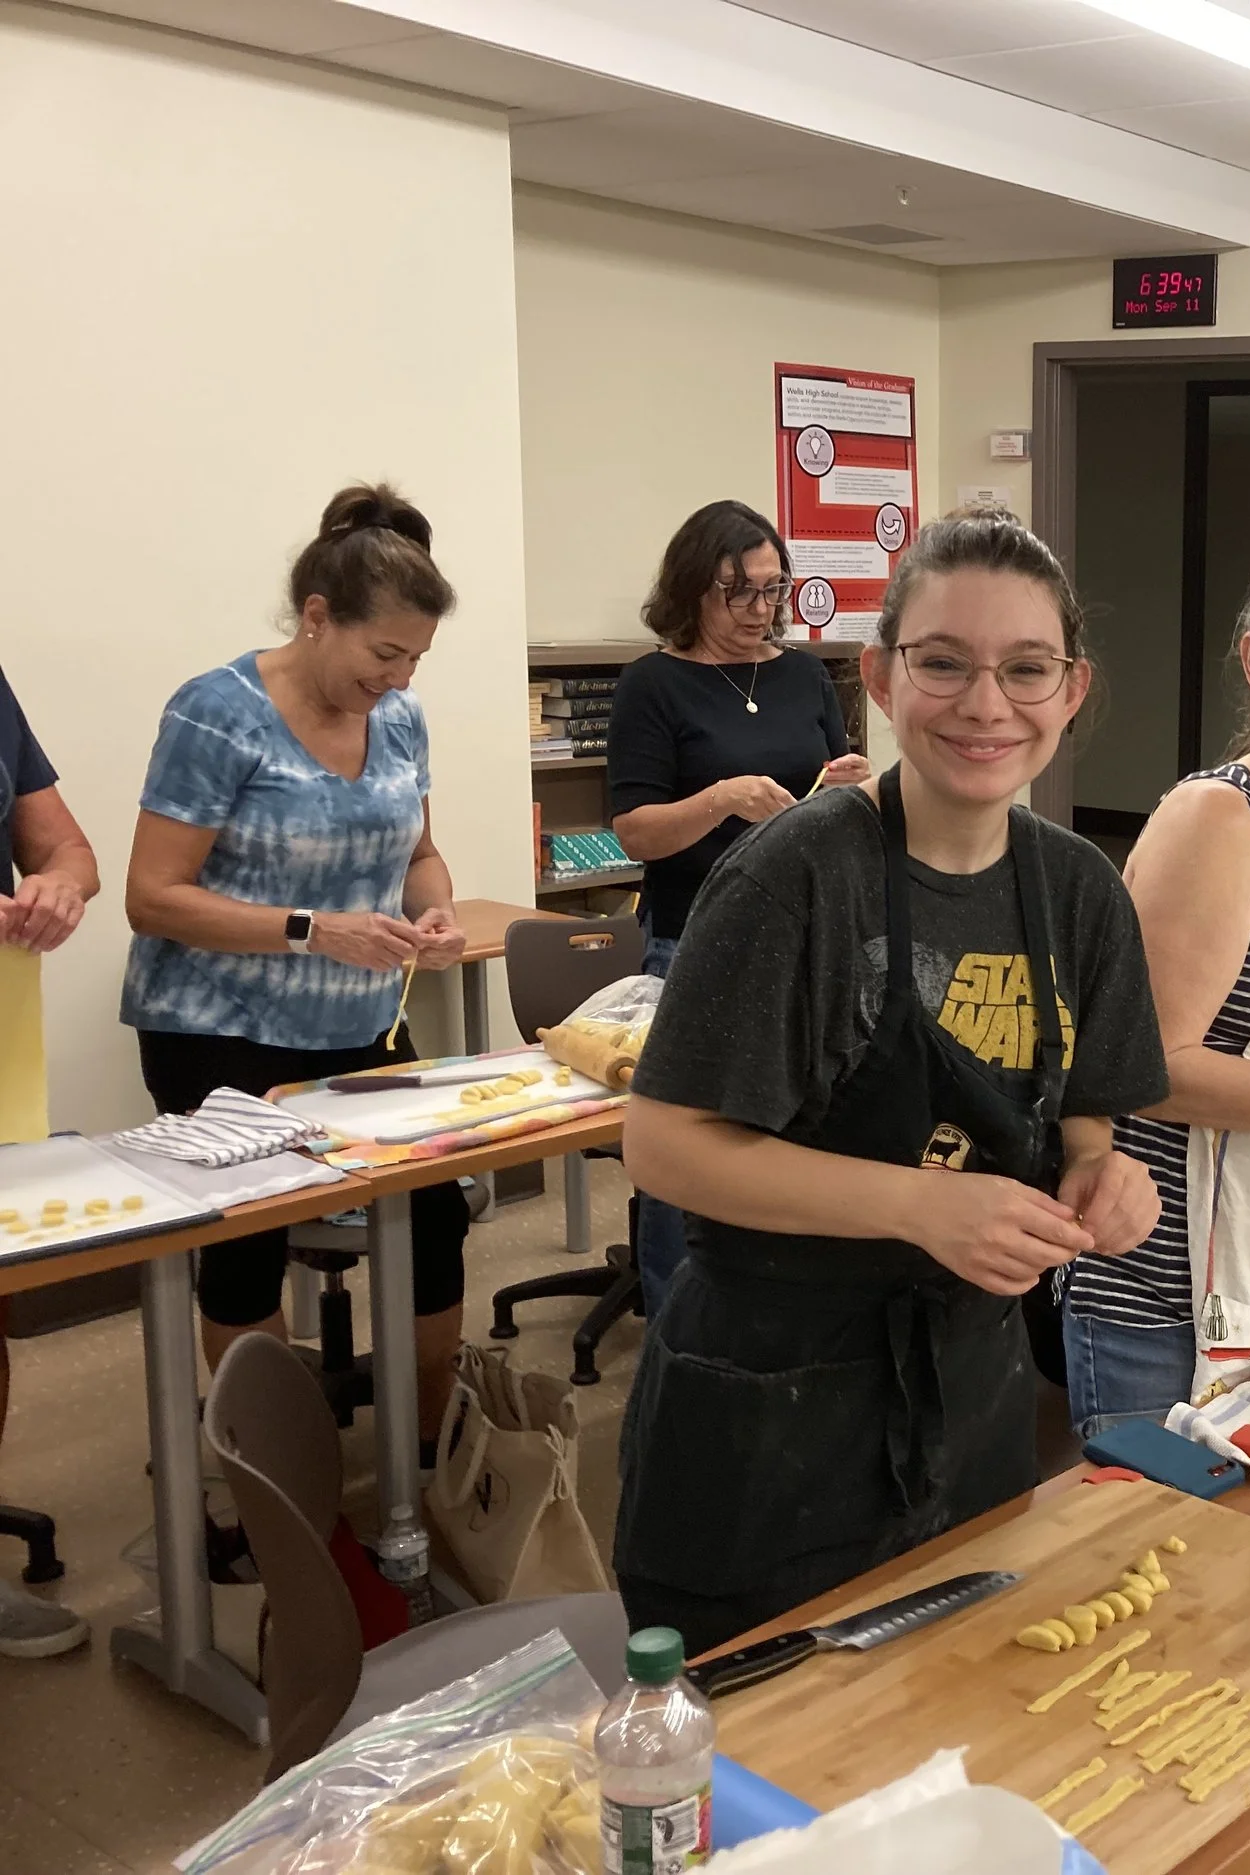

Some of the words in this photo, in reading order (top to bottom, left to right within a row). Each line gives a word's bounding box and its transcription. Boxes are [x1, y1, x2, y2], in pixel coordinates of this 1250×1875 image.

[1125, 301, 1148, 313] Mon
[1155, 300, 1177, 312] Sep
[1186, 298, 1199, 311] 11
[848, 377, 866, 387] Vision
[867, 380, 874, 388] of
[874, 381, 883, 389] the
[786, 387, 804, 396] Wells
[805, 388, 820, 398] High
[821, 389, 839, 399] School
[803, 458, 828, 468] Knowing
[805, 608, 829, 617] Relating
